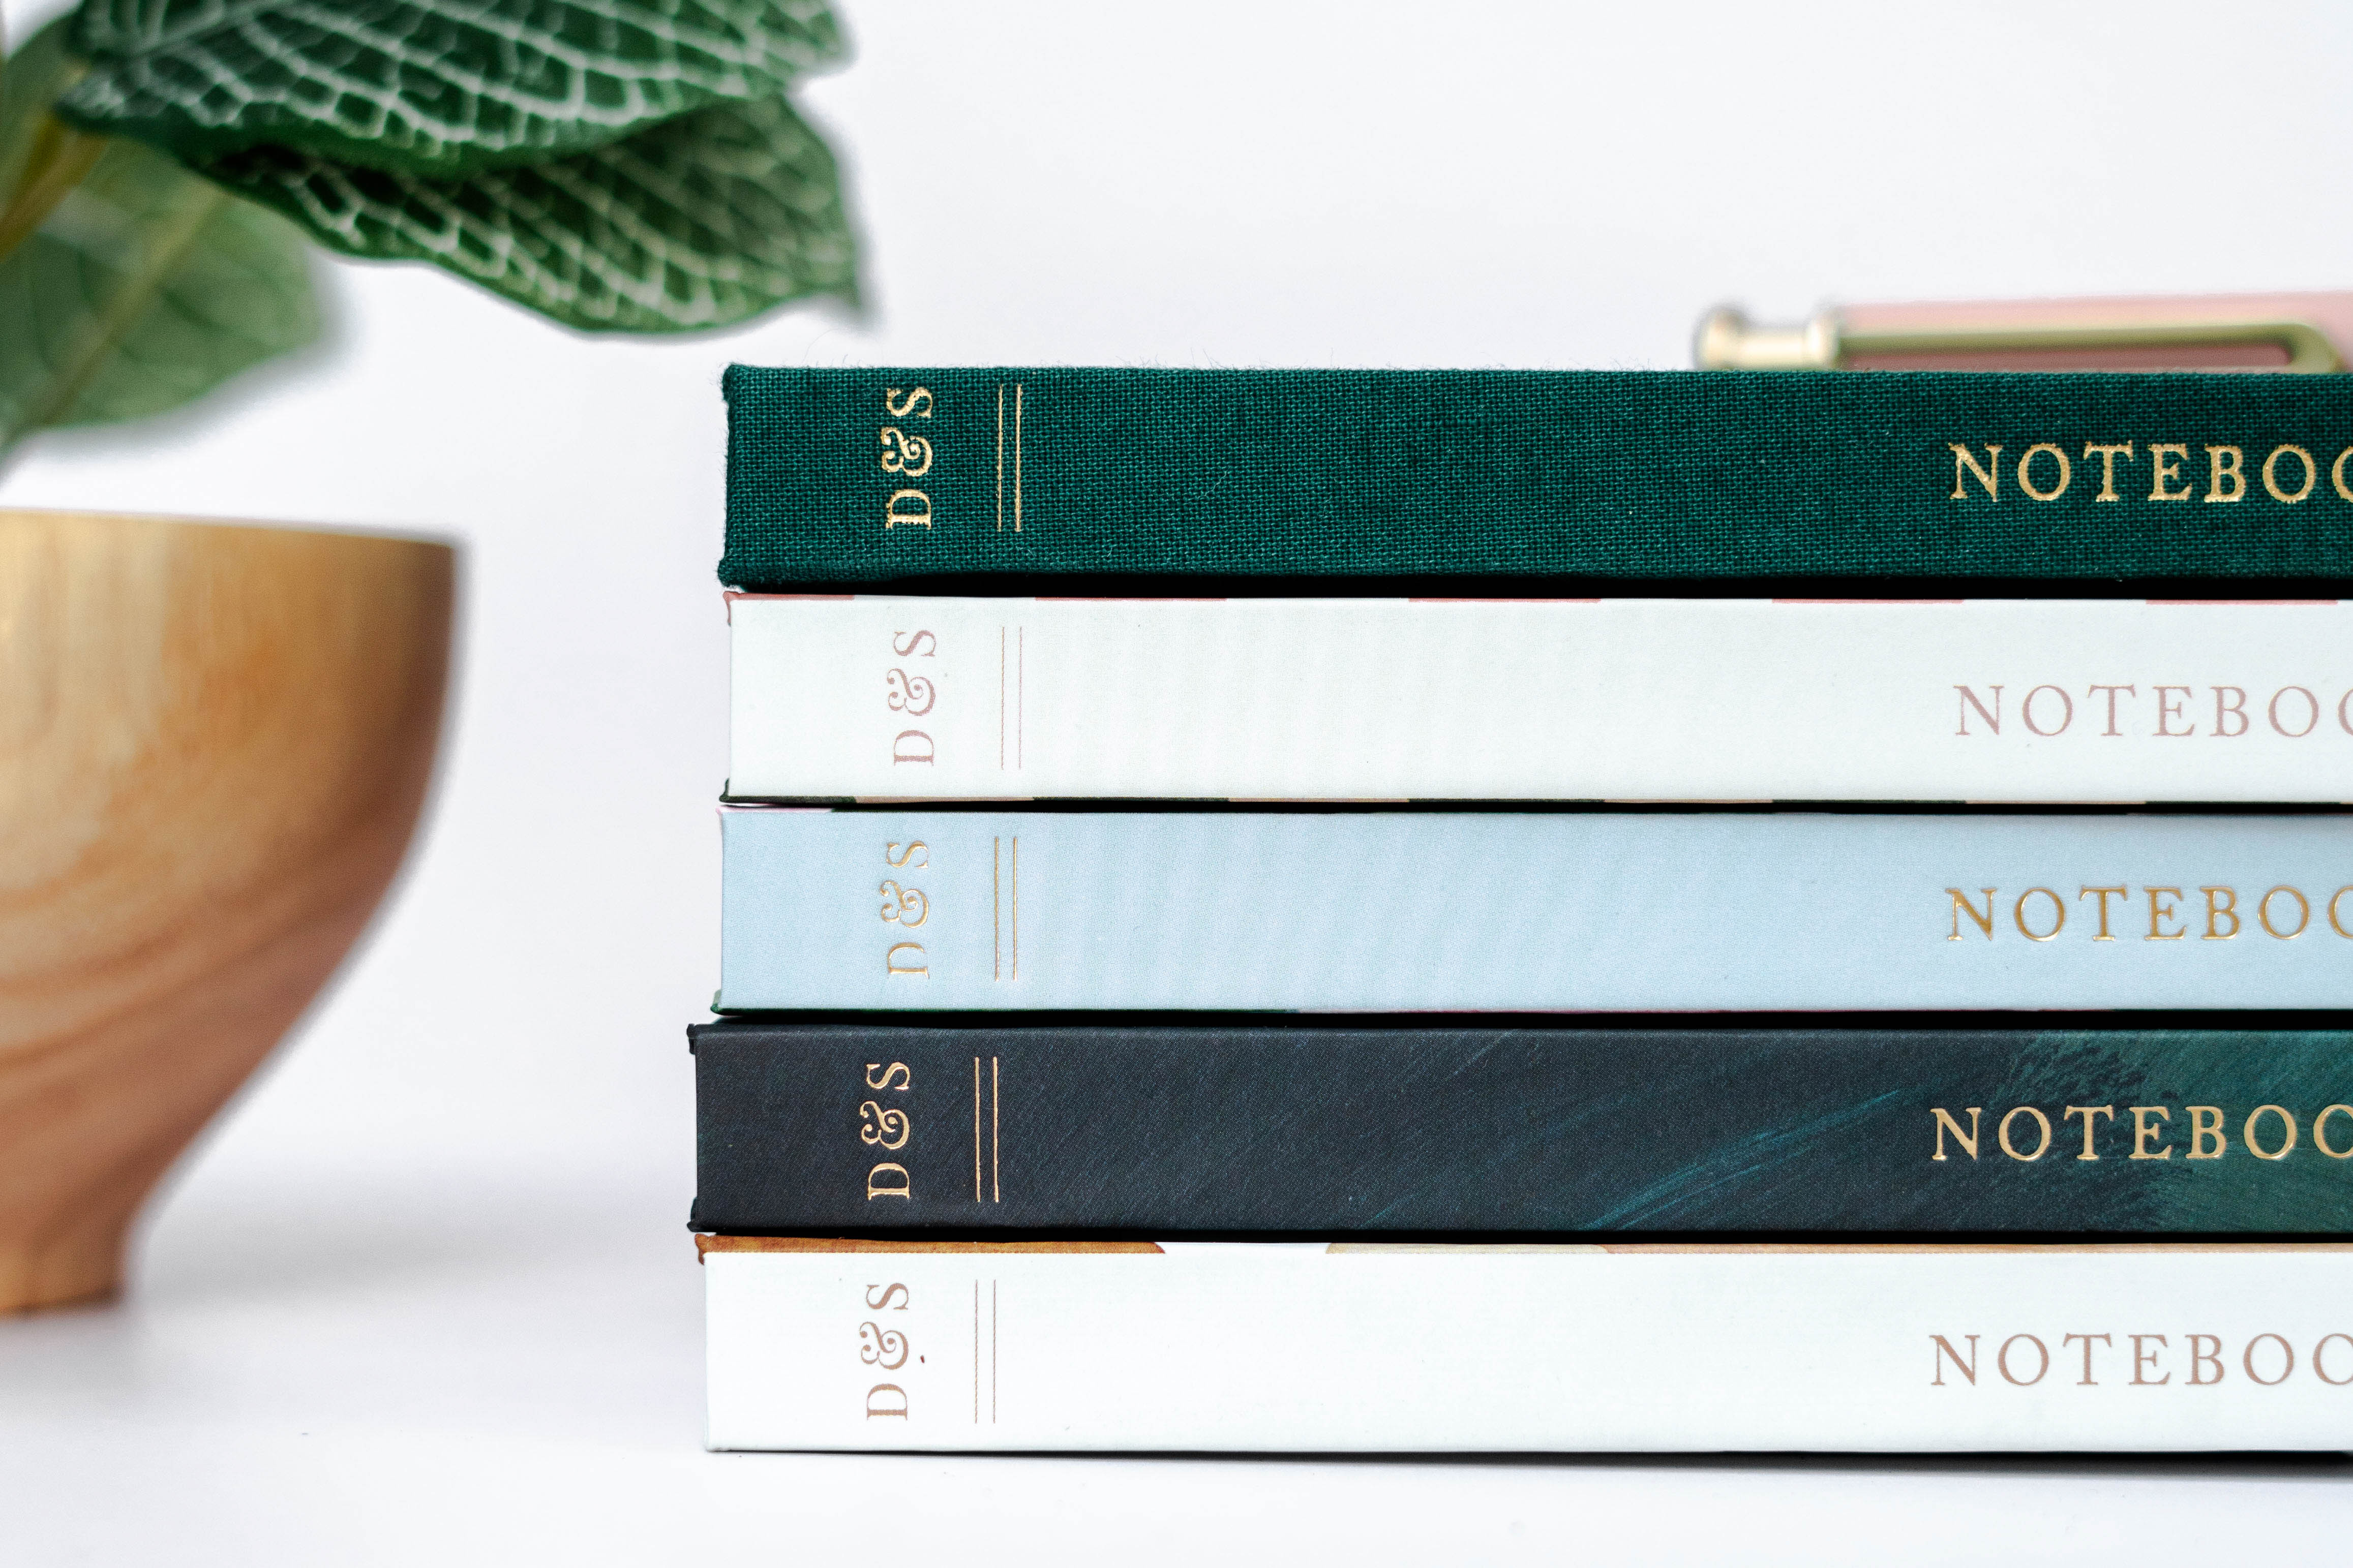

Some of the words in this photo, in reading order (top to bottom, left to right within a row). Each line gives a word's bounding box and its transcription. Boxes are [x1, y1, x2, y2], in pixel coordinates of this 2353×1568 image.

[881, 387, 932, 529] D&S
[887, 630, 936, 766] D&S
[1953, 684, 2353, 737] NOTEBO
[880, 841, 929, 978] D&S
[860, 1062, 910, 1200] D&S
[860, 1282, 909, 1420] D&S
